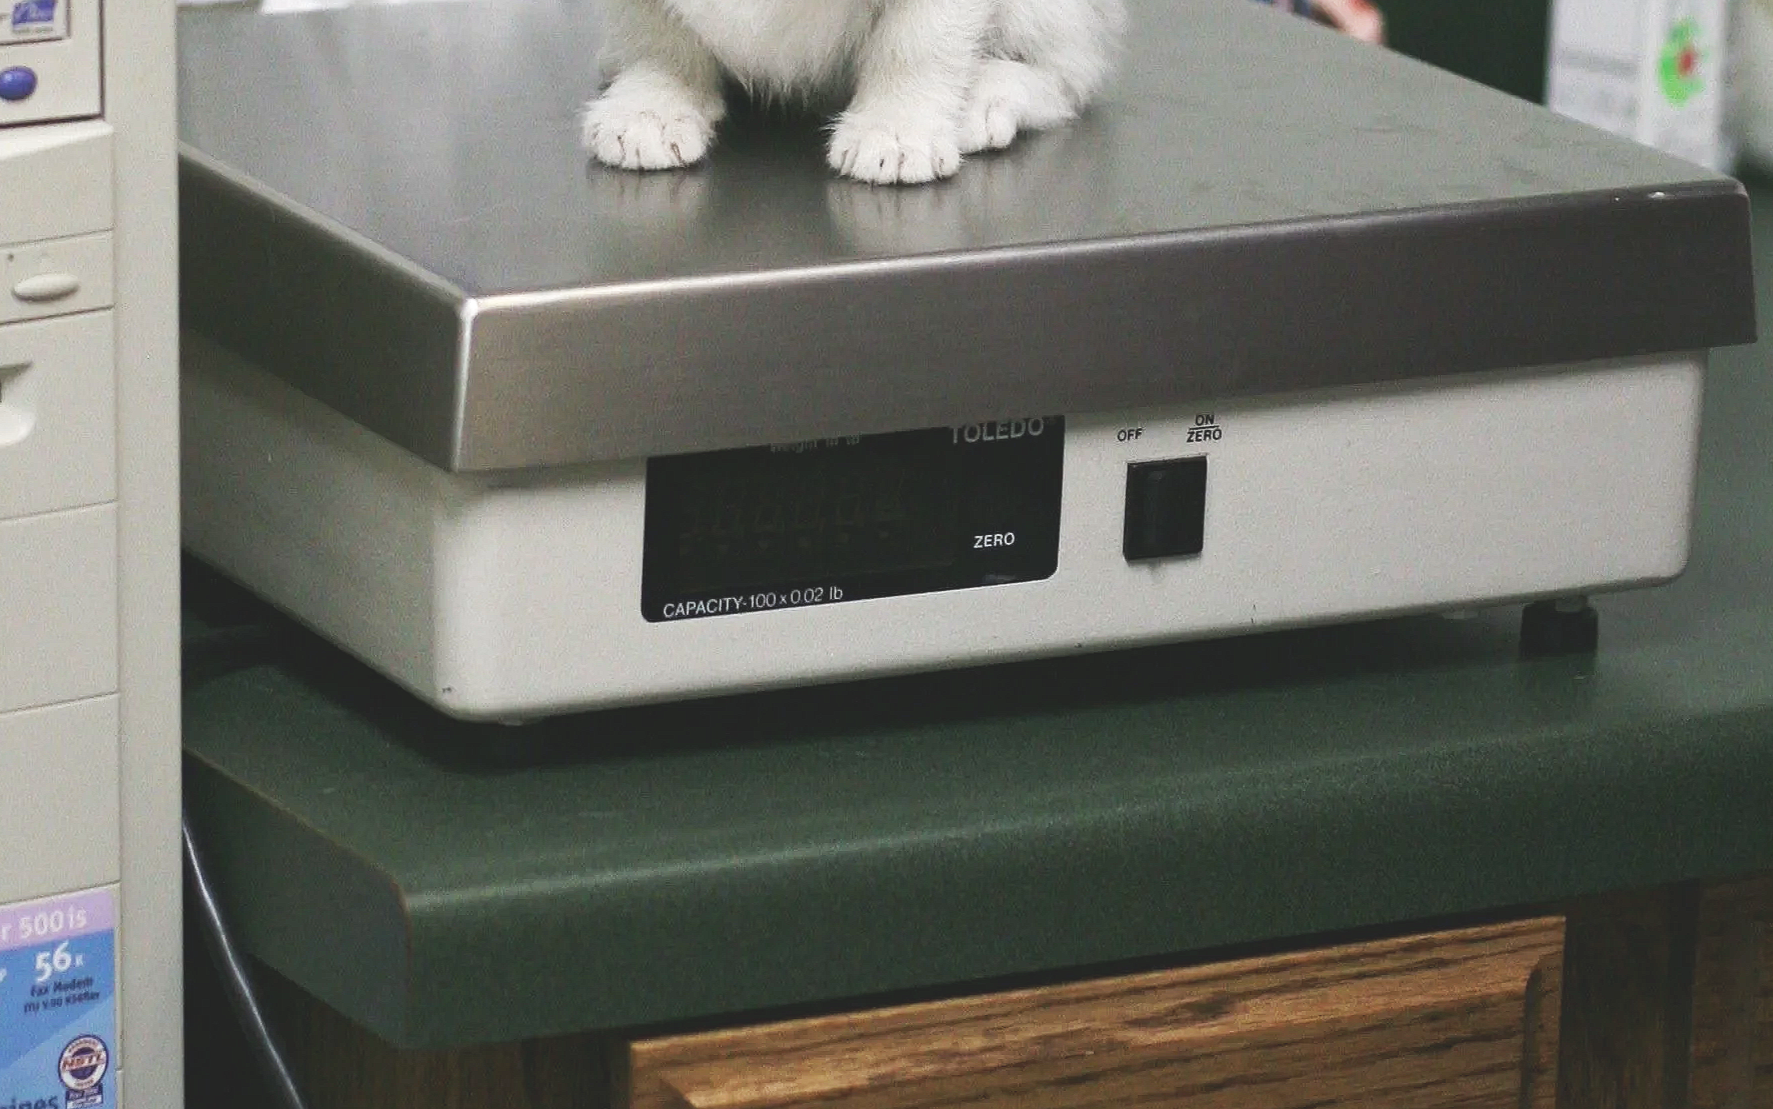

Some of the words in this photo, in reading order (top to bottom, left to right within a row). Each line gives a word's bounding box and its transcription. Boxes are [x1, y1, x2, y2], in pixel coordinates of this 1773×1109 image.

[1194, 413, 1215, 426] ON
[951, 417, 1044, 445] TOLEDO
[1117, 428, 1143, 442] OFF
[1186, 429, 1222, 443] ZERO
[973, 532, 1016, 549] ZERO
[828, 586, 844, 602] lb
